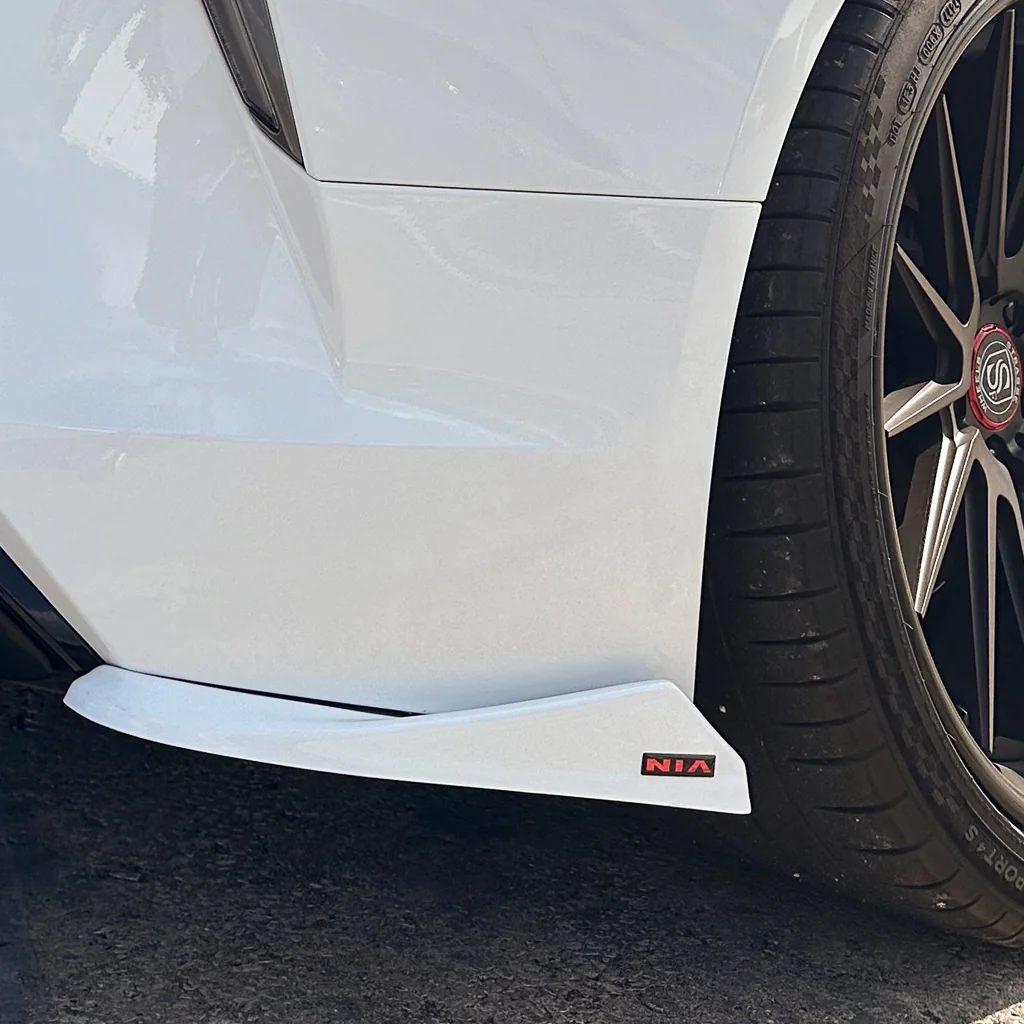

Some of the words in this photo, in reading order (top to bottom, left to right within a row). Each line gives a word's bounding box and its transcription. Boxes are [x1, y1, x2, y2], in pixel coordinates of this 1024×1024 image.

[863, 301, 873, 332] MADE
[868, 243, 878, 285] FRANCE
[645, 758, 711, 773] NIA
